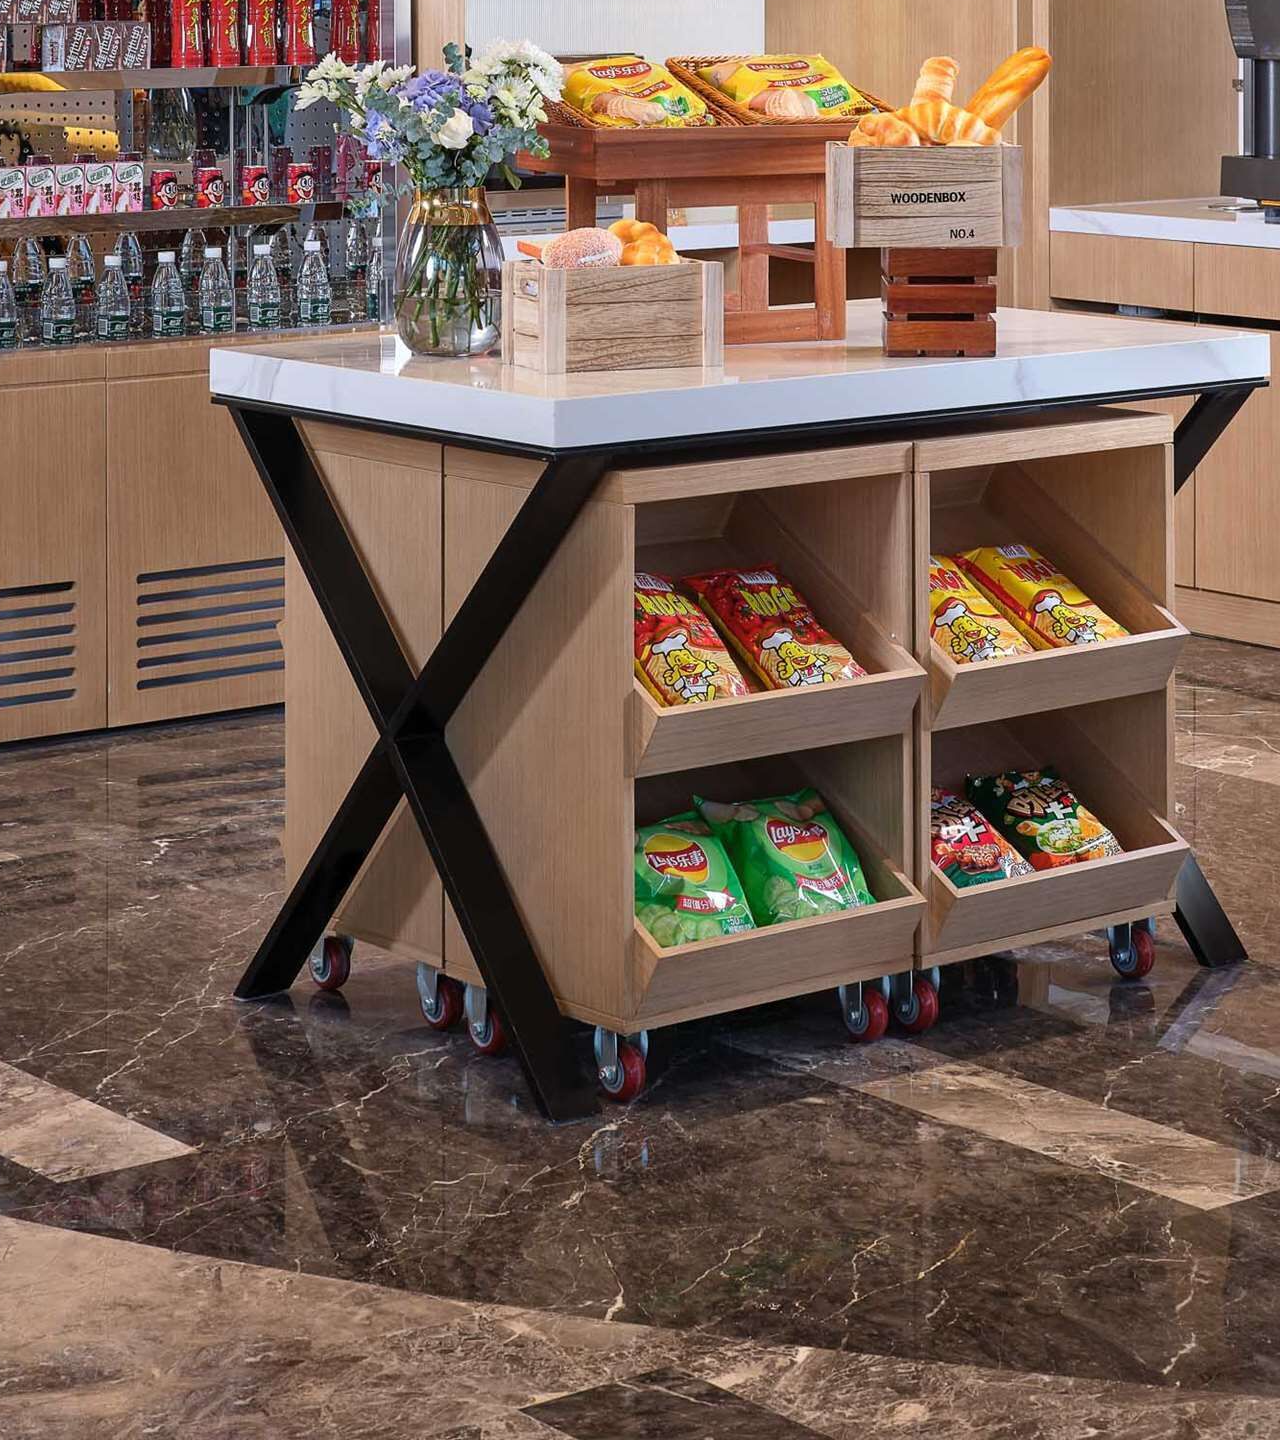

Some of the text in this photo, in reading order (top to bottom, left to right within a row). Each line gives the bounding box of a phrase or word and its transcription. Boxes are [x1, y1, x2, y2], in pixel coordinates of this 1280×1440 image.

[890, 192, 966, 204] WOODENBOX
[950, 229, 974, 238] NO.4
[770, 826, 800, 843] Lay's
[678, 850, 704, 867] 乐事
